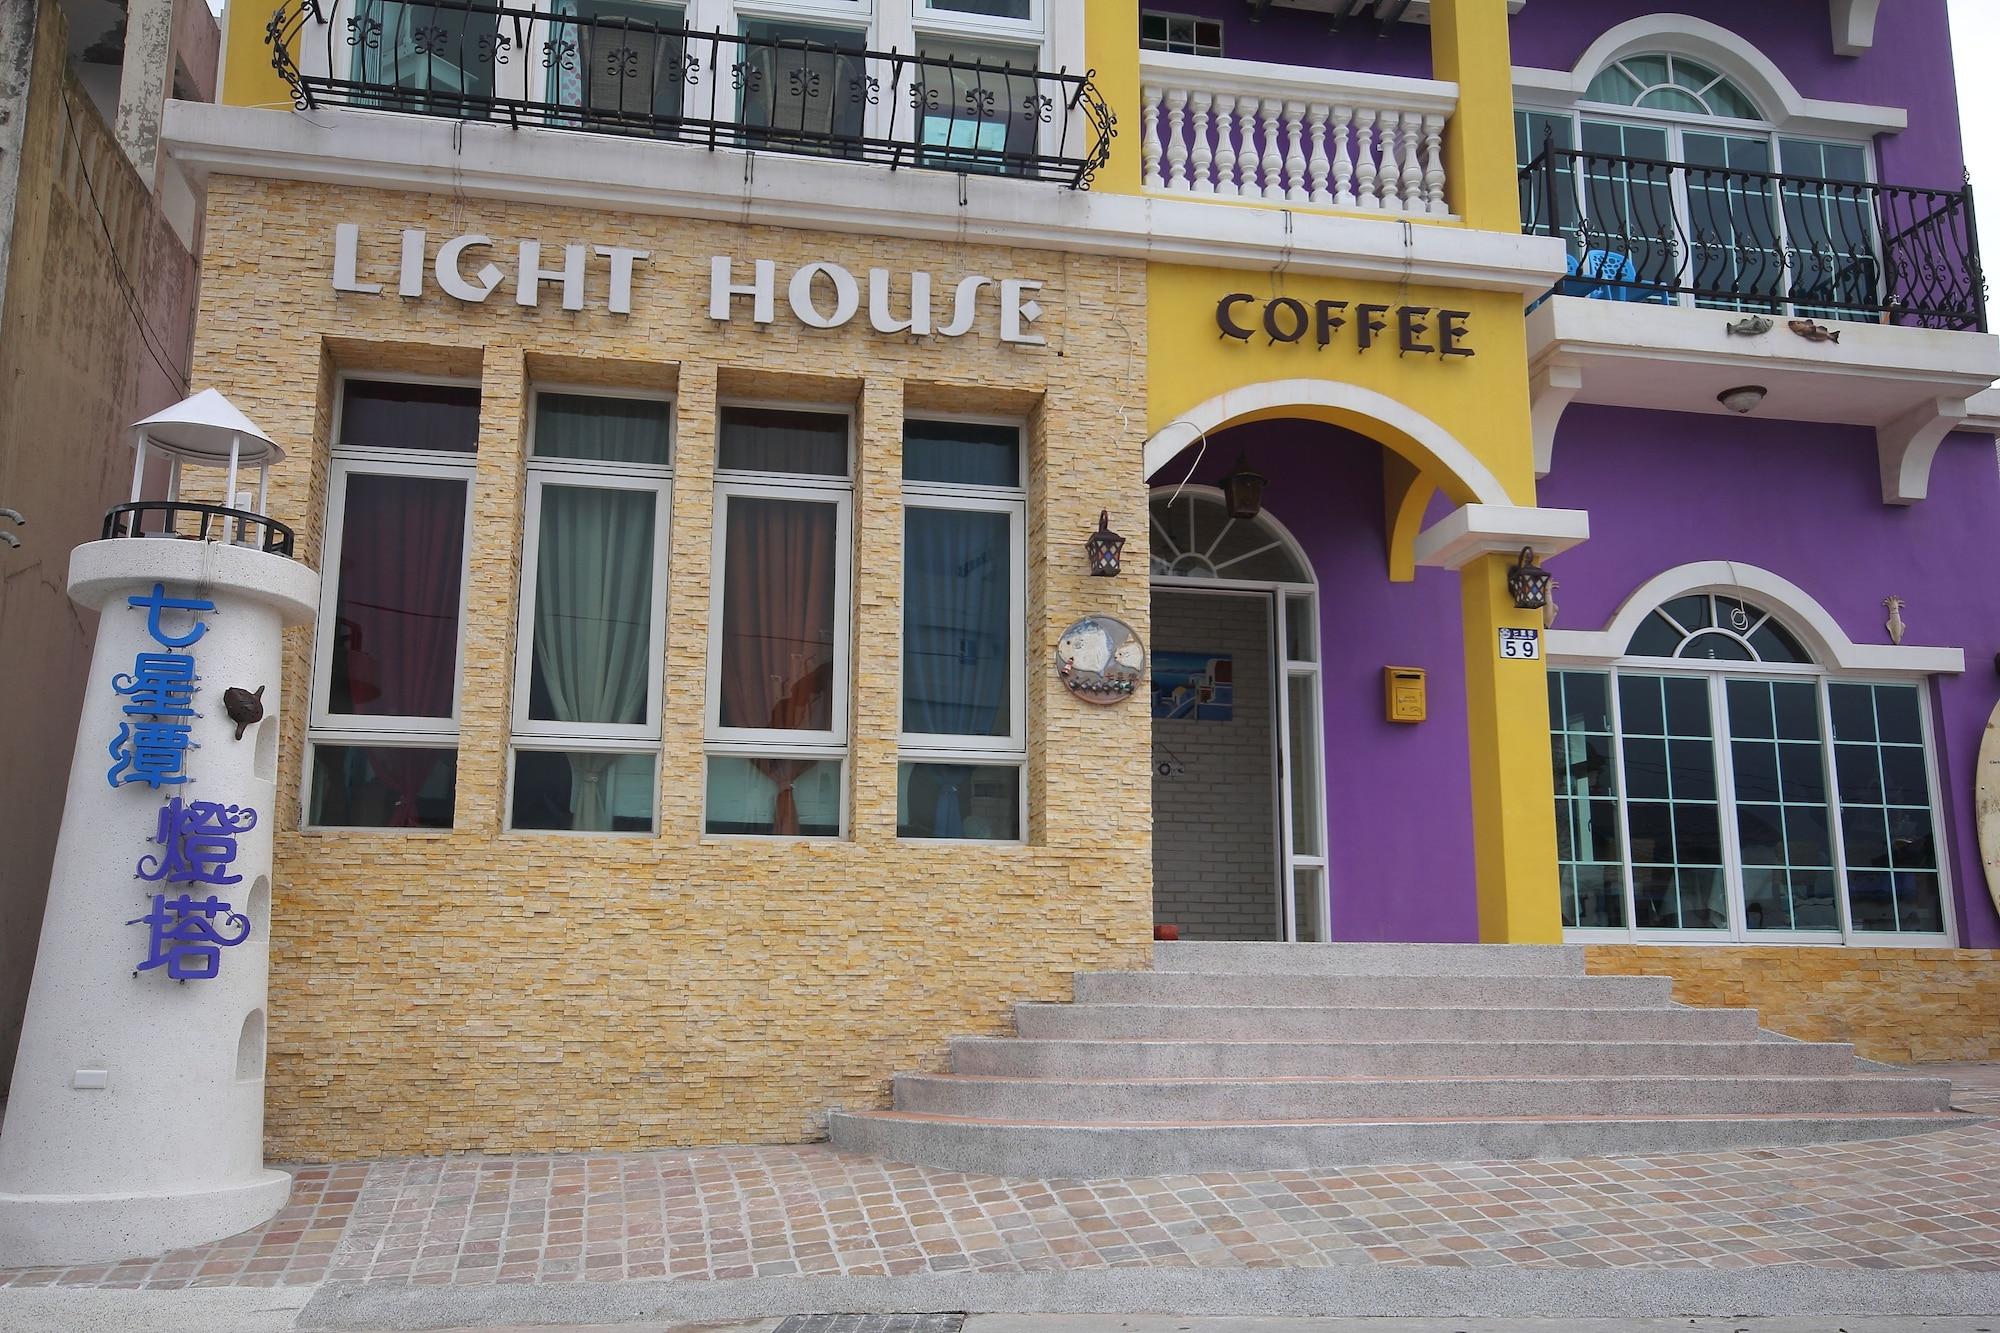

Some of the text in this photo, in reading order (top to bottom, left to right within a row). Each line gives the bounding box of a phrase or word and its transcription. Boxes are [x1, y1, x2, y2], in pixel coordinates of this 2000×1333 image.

[333, 223, 1046, 345] LIGHT HOUSE
[1215, 293, 1475, 356] COFFEE
[108, 583, 216, 789] 七星潭
[1505, 640, 1534, 657] 59
[137, 796, 258, 980] 燈塔
